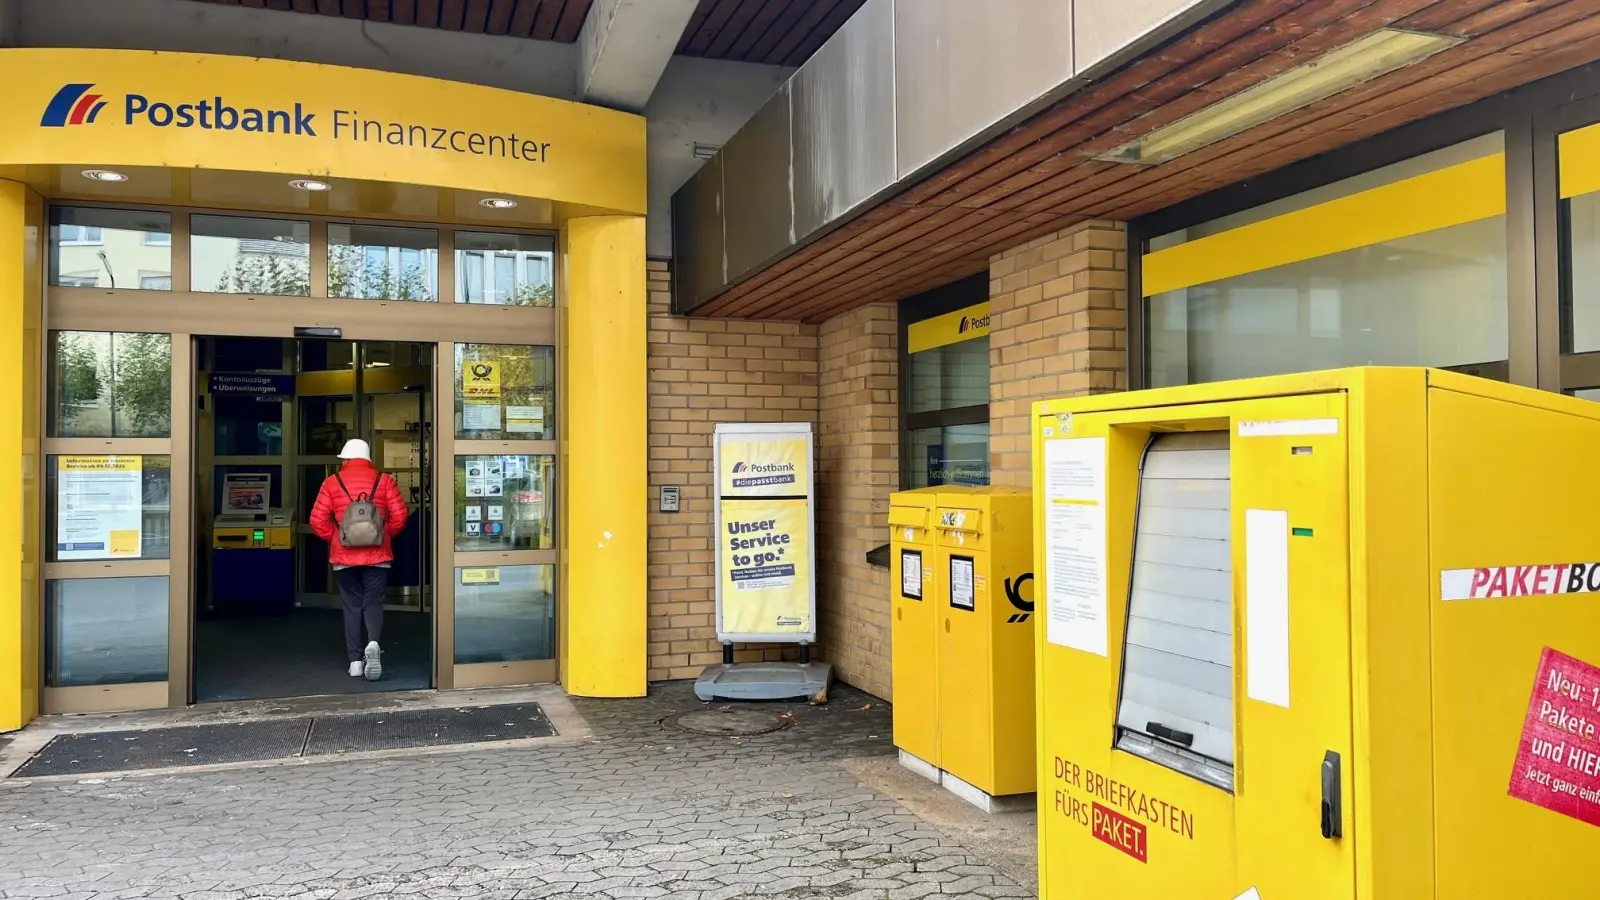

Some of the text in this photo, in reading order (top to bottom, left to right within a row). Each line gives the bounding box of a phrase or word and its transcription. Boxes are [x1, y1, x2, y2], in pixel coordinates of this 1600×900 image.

[125, 93, 551, 163] Postbank Finanzcenter
[218, 376, 272, 384] Kontoauszüge
[218, 383, 277, 393] Überweisungen
[751, 462, 795, 473] Postbank
[736, 475, 792, 486] #diepasstbank
[727, 519, 776, 535] Unser
[730, 532, 790, 551] Service
[732, 554, 751, 567] to
[1547, 668, 1586, 702] Neu:
[1539, 700, 1595, 739] Pakete
[1531, 737, 1566, 764] und
[1525, 765, 1552, 786] jetzt
[1552, 778, 1579, 796] ganz
[1055, 756, 1194, 840] DER BRIEFKASTEN
[1055, 789, 1144, 856] FÜRS PAKET.
